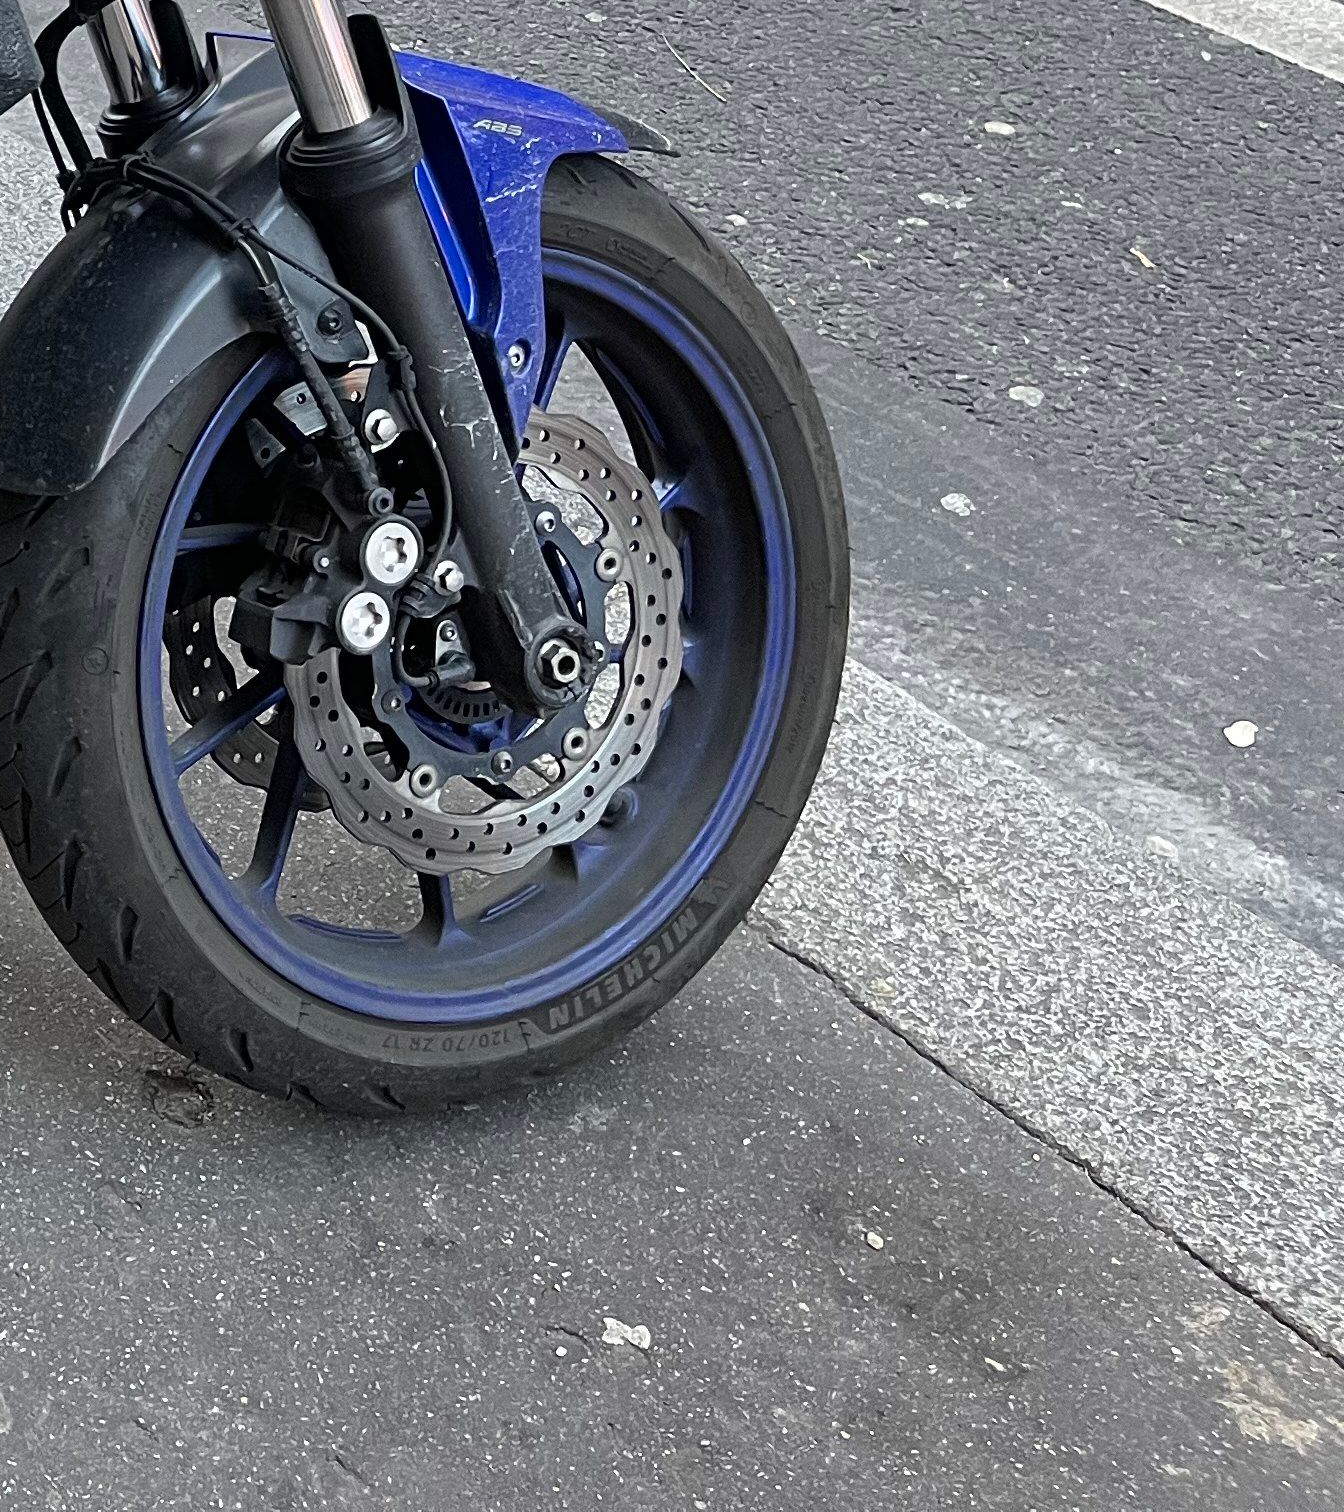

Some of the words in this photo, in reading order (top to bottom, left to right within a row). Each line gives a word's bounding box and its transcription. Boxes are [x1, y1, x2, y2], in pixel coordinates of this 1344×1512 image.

[472, 119, 523, 136] ABS
[548, 907, 699, 1030] MICHELIN
[442, 1028, 511, 1053] 120/70
